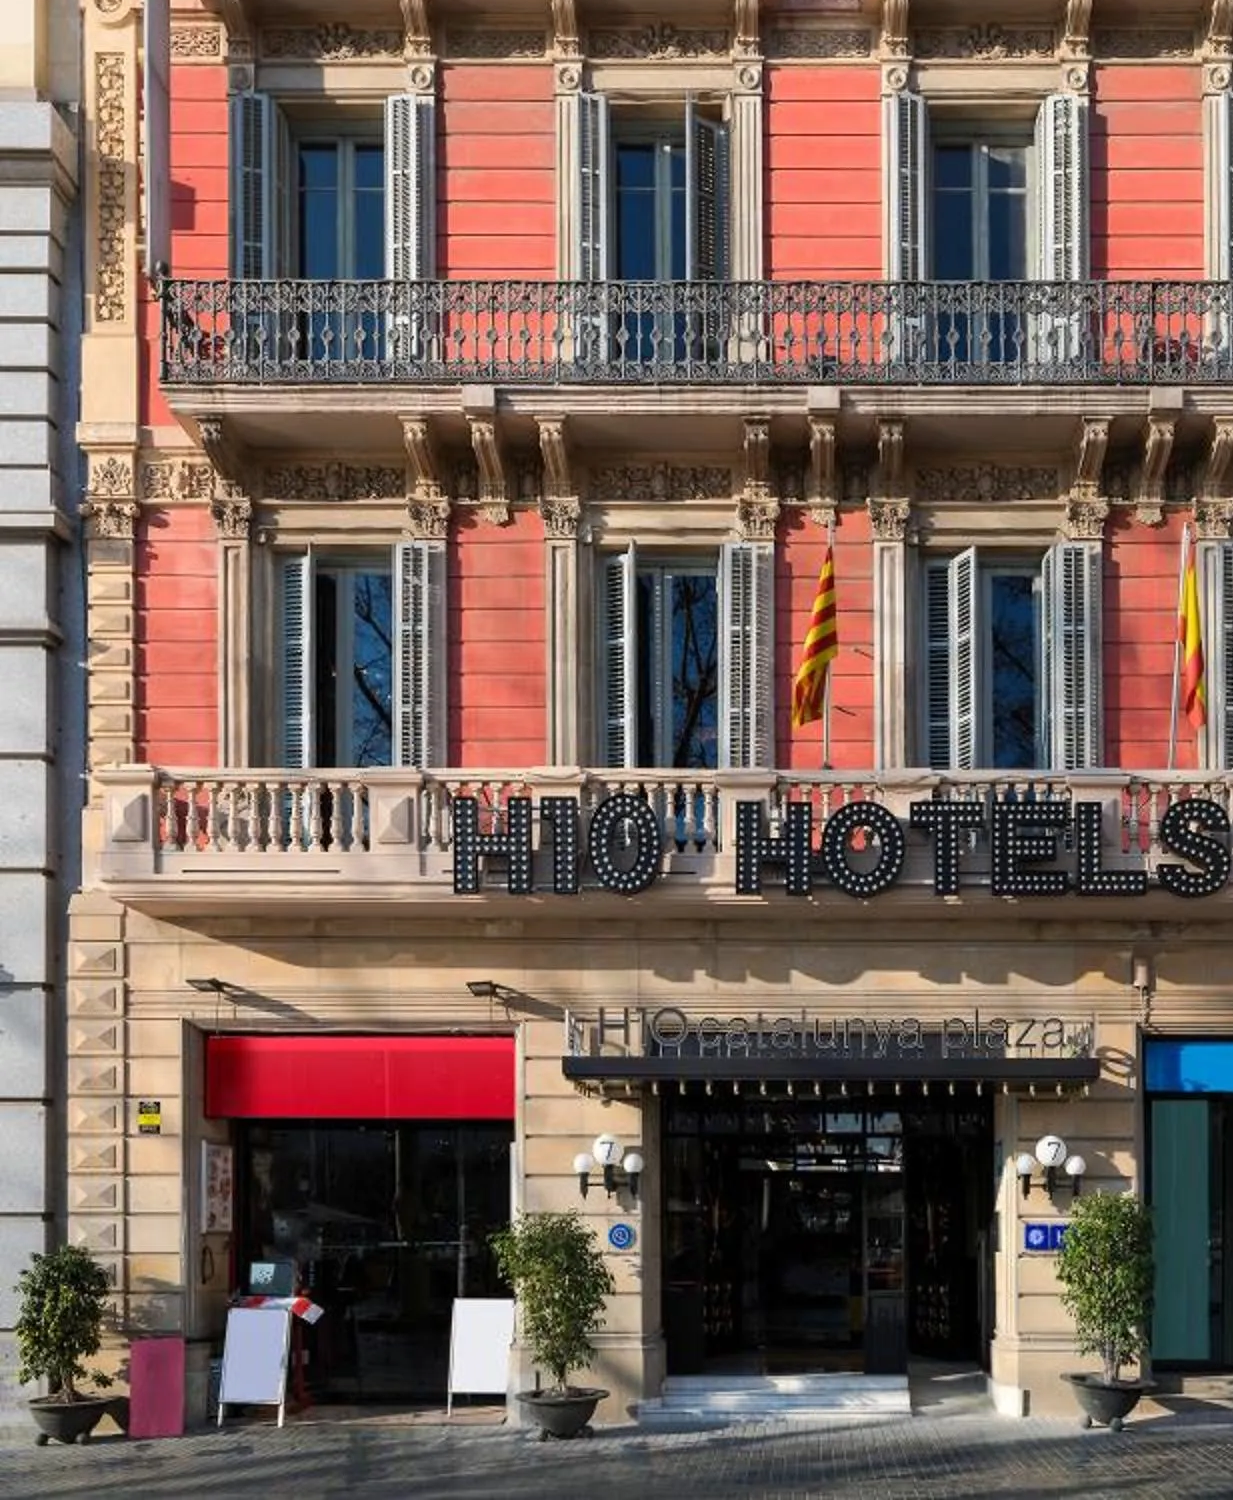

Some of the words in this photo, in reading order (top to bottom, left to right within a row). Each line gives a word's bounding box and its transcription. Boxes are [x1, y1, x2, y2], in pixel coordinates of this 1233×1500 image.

[451, 794, 662, 897] H10
[735, 799, 1233, 898] HOTELS
[698, 1009, 925, 1057] catalunya
[941, 1007, 1067, 1057] plaza
[600, 1141, 614, 1161] 7
[1047, 1141, 1061, 1161] 7
